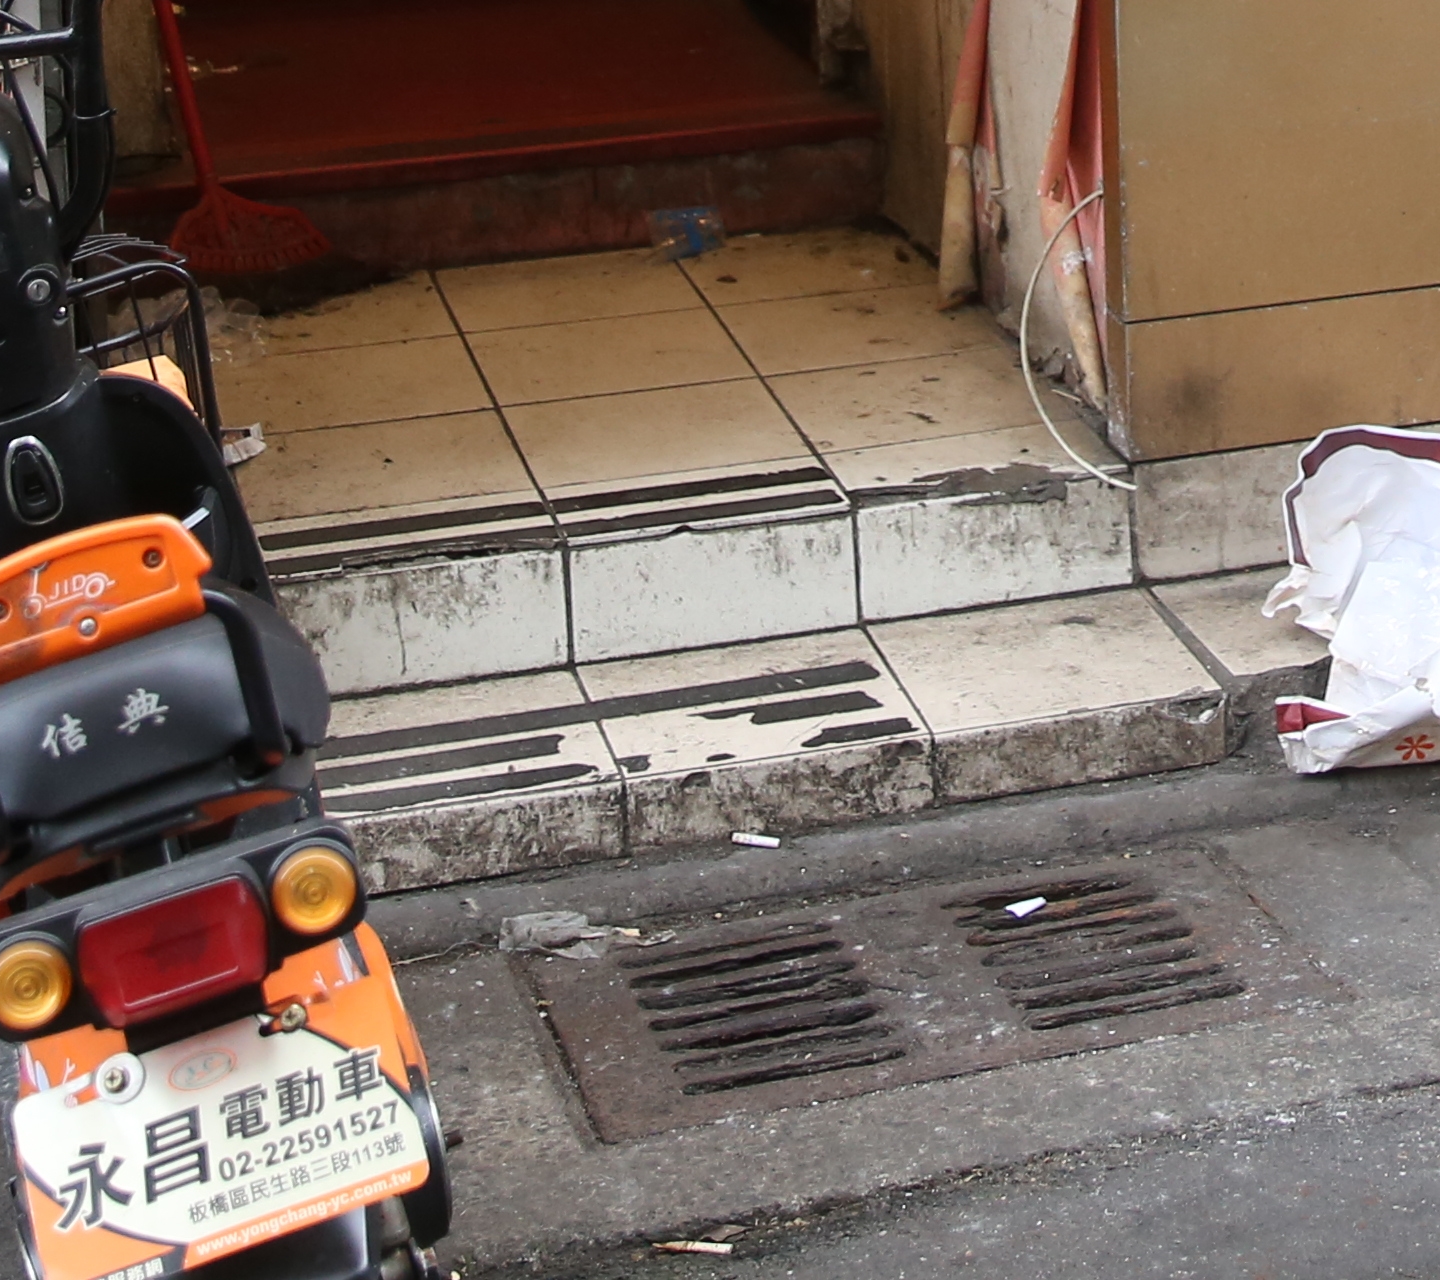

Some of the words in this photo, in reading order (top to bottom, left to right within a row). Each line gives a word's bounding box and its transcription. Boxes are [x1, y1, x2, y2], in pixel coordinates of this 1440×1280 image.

[53, 1105, 212, 1231] 永昌
[218, 1047, 385, 1140] 電動車
[187, 1131, 408, 1226] 板橋區民生路三段113號
[218, 1099, 400, 1183] 02-22591527
[196, 1168, 414, 1257] www.yongchang-yc.com.tw
